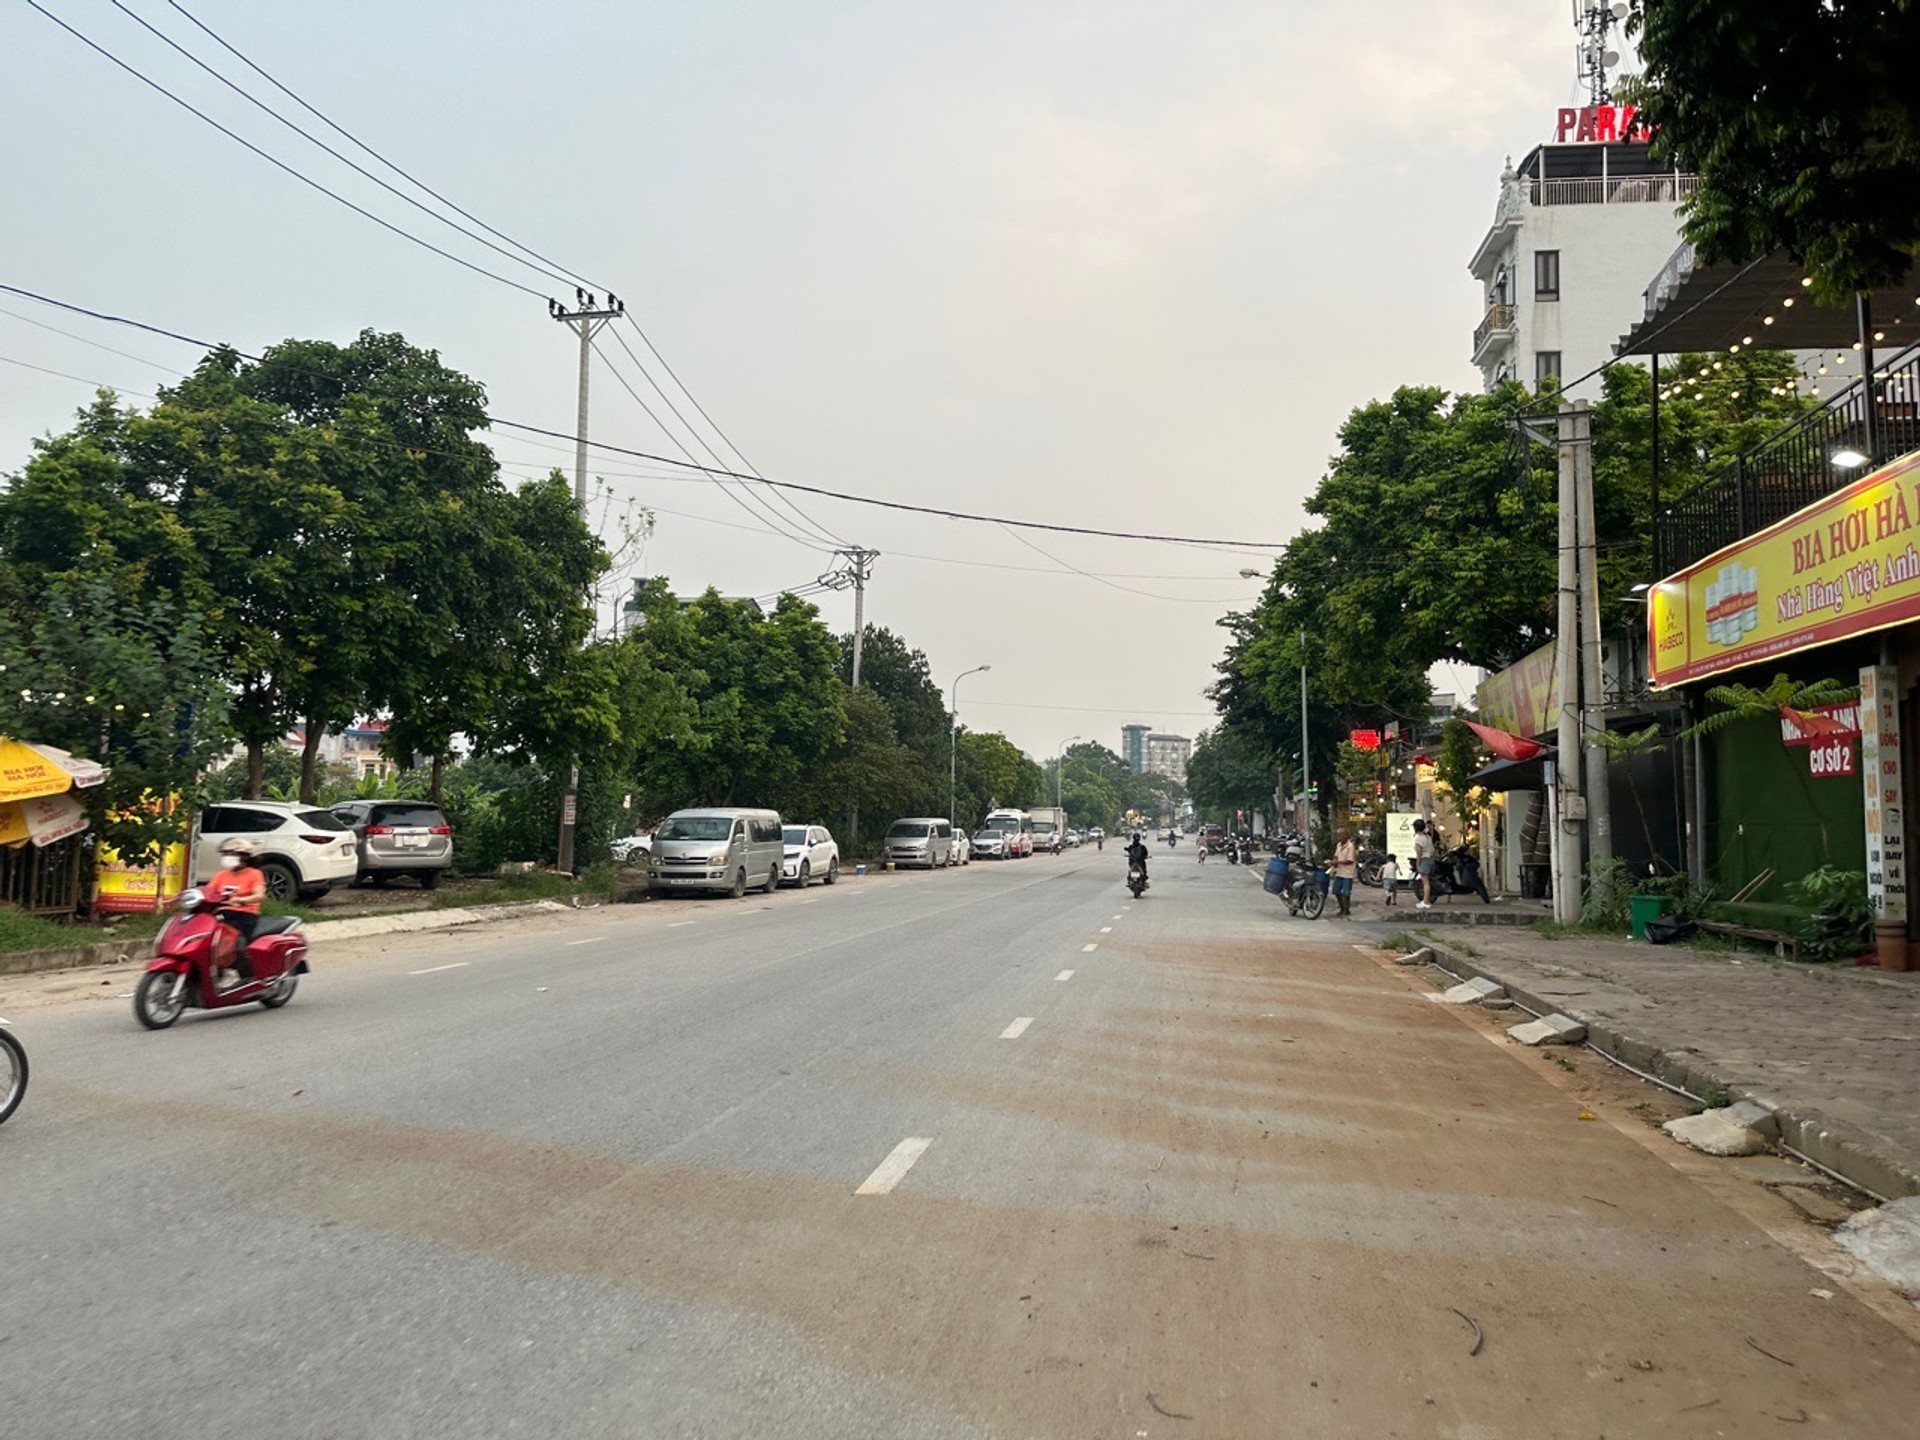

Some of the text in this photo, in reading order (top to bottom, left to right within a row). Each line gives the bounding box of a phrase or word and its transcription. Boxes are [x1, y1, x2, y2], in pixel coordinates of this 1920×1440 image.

[1792, 530, 1826, 575] BIA
[1828, 507, 1870, 561] HƠI
[1874, 482, 1912, 541] HÀ
[1777, 585, 1803, 623] Nhà
[1805, 575, 1844, 612] Hàng
[1846, 558, 1880, 603] Việt
[1883, 542, 1920, 588] Anh
[1810, 740, 1851, 773] CƠ SỞ 2
[1885, 851, 1902, 861] BAY
